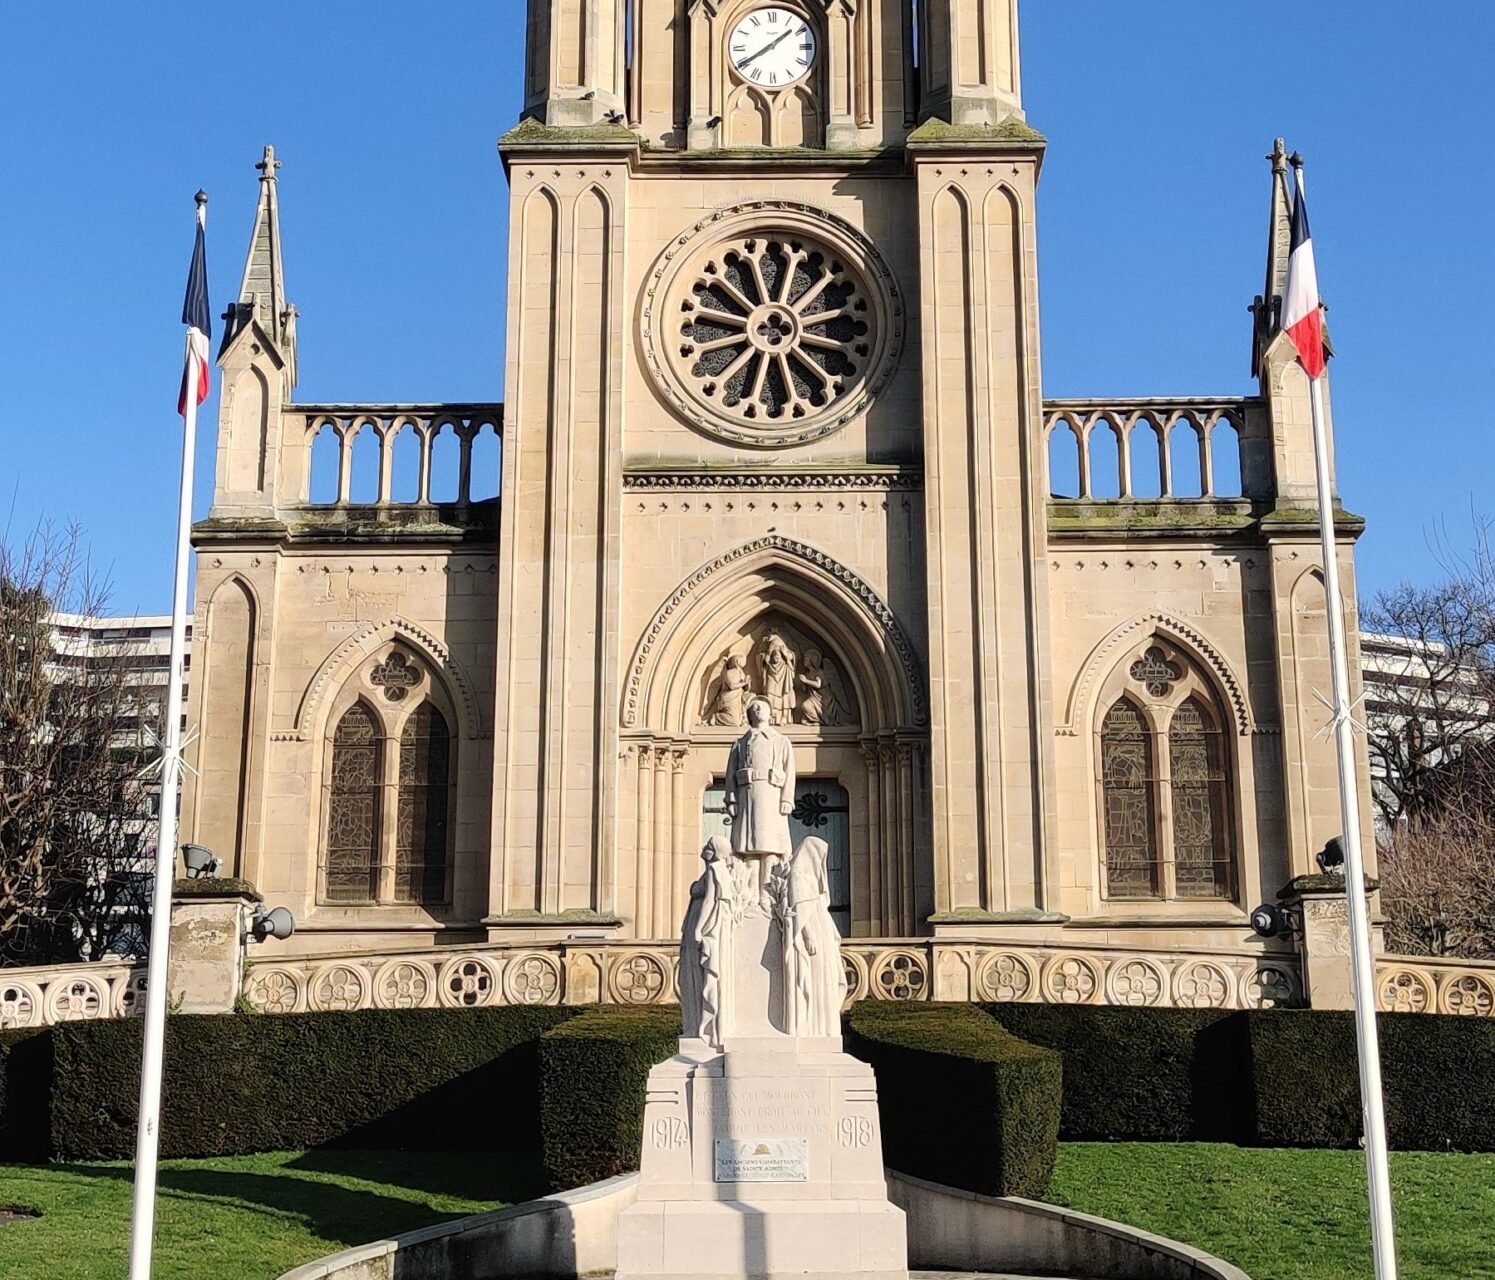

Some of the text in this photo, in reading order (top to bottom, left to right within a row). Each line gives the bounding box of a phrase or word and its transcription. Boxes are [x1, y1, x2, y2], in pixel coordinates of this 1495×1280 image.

[749, 15, 761, 28] XI
[767, 11, 777, 23] XII
[737, 28, 750, 37] X
[799, 43, 813, 51] III
[750, 67, 762, 81] VII
[769, 71, 777, 84] VI
[650, 1116, 689, 1150] 1914
[836, 1115, 875, 1149] 1918
